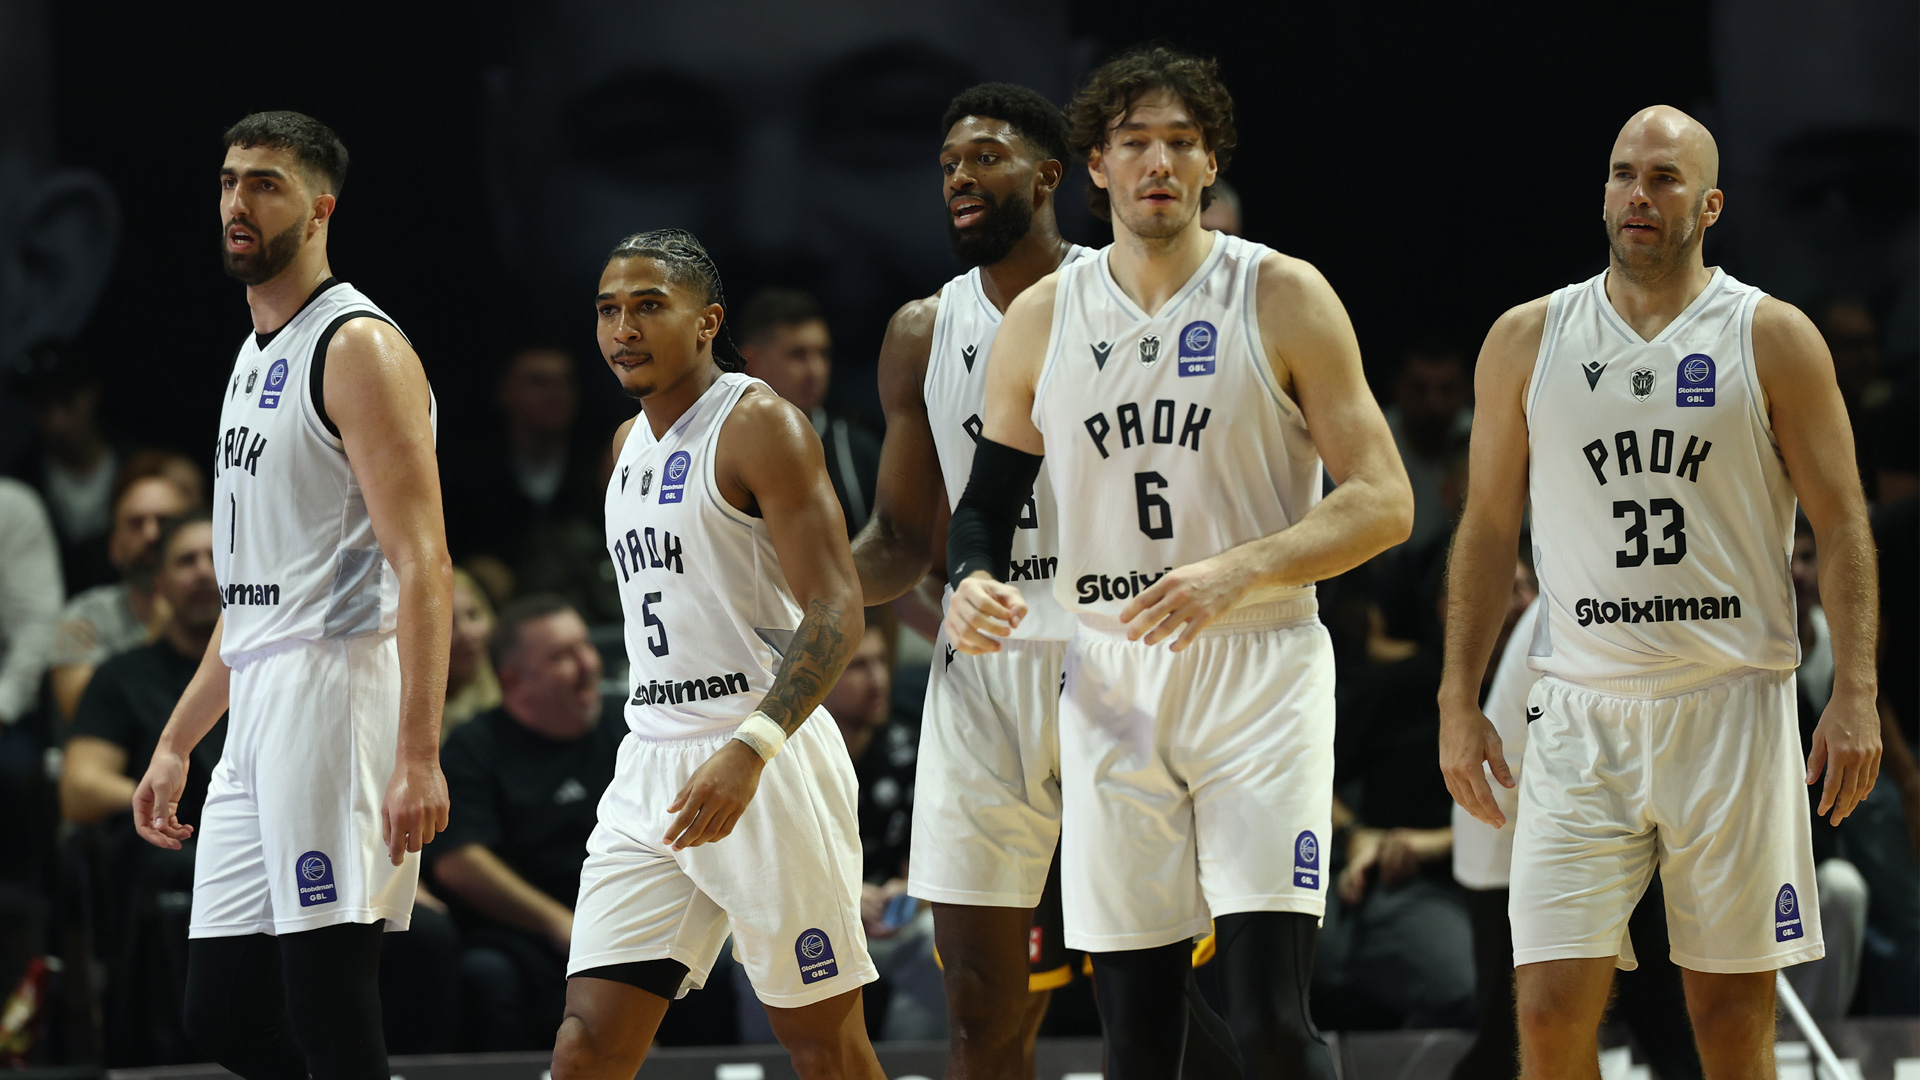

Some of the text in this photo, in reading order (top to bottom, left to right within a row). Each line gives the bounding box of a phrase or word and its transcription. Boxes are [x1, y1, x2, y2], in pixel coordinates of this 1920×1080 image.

[1084, 400, 1212, 460] PAOK
[1582, 428, 1713, 486] PAOK
[1134, 471, 1174, 540] 6
[1613, 498, 1687, 568] 33
[614, 526, 684, 584] PAOK
[1076, 567, 1173, 604] Stoix
[1575, 595, 1742, 627] Stoiximan
[642, 591, 669, 658] 5
[310, 893, 327, 901] GBL
[811, 969, 829, 978] GBL
